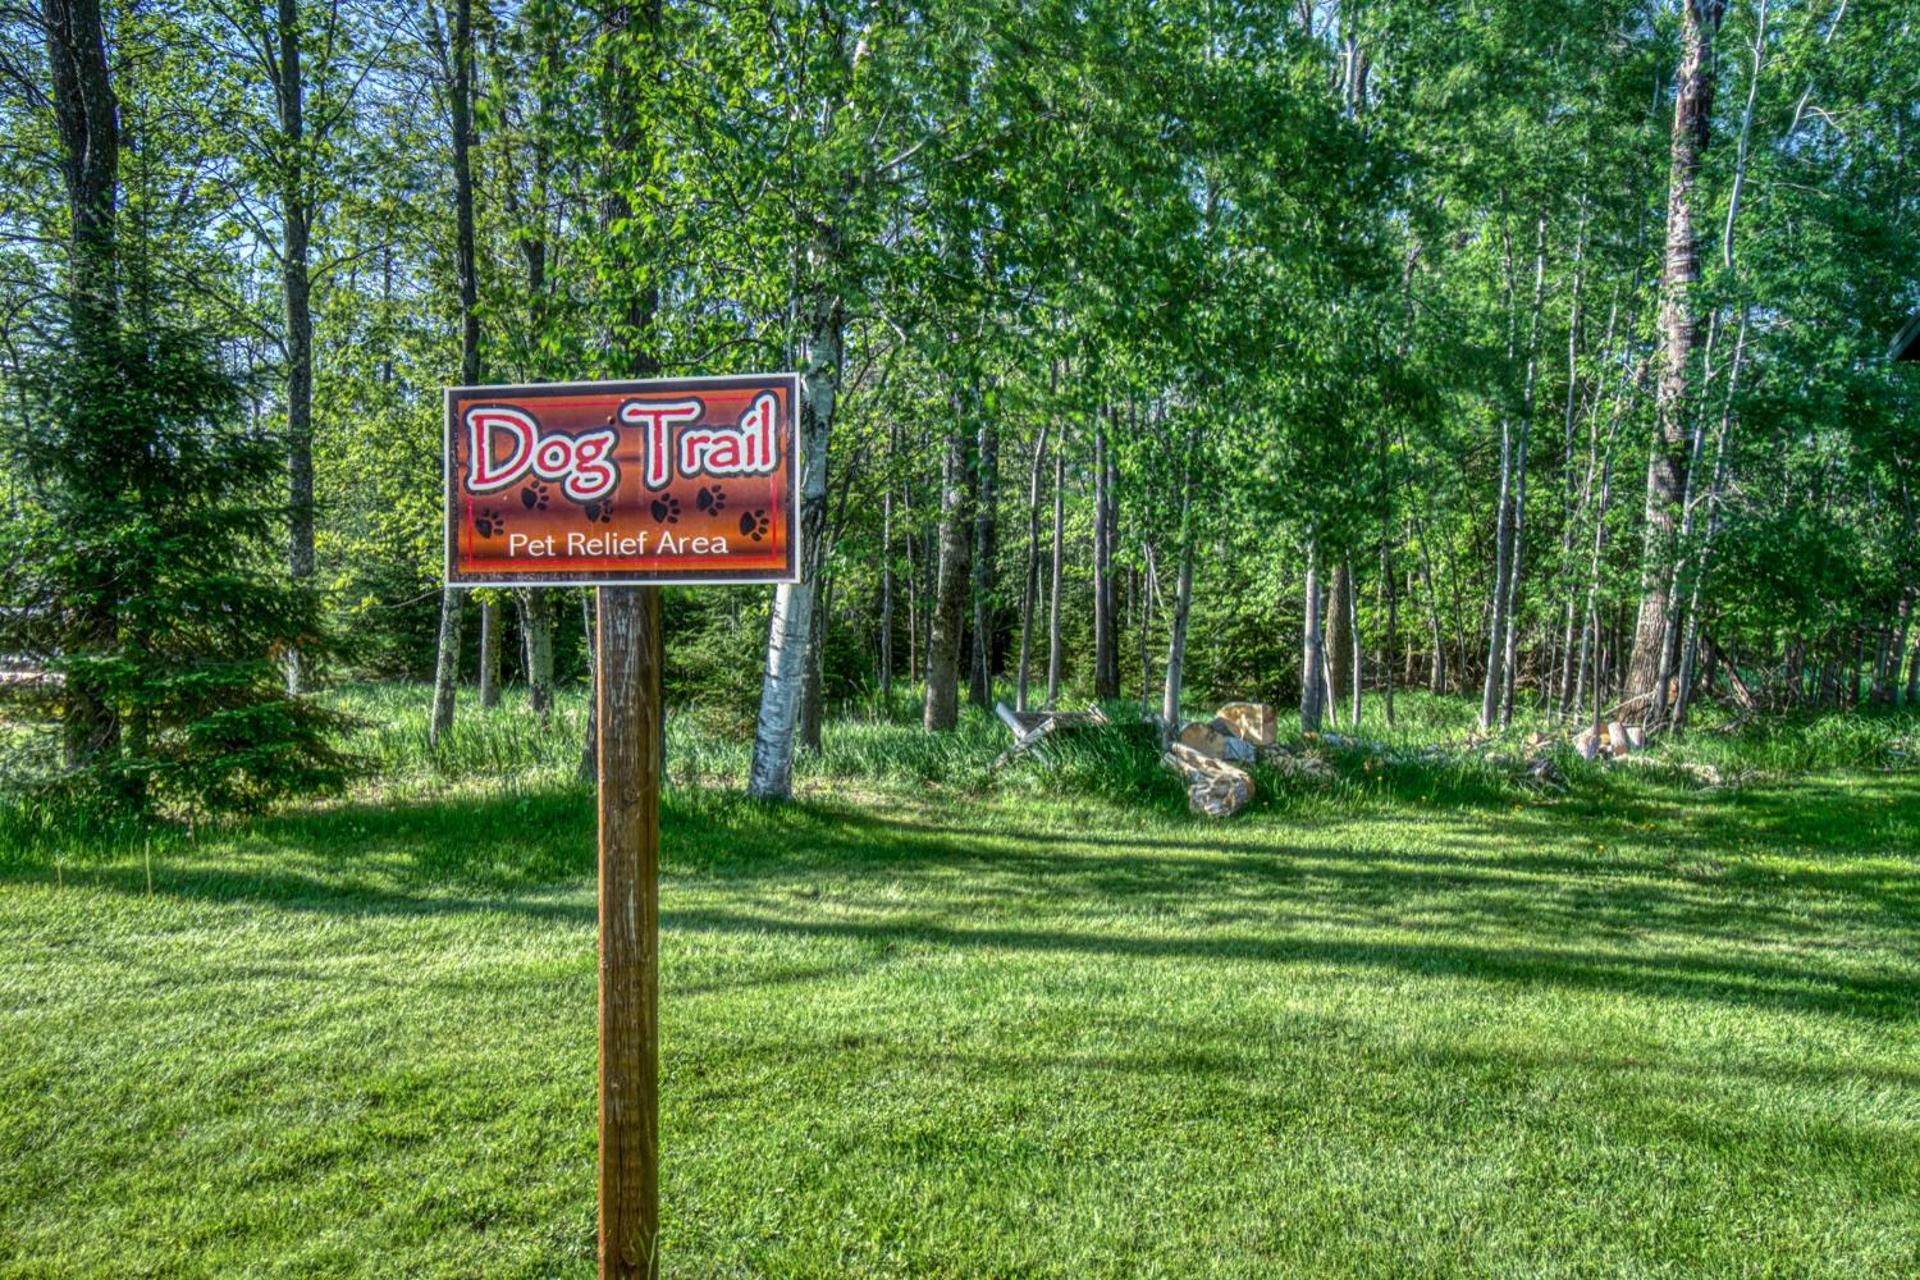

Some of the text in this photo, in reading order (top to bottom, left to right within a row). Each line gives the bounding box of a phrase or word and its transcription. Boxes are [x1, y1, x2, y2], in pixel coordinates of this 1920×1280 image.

[467, 394, 776, 499] Dog Trail
[509, 531, 729, 557] Pet Relief Area
